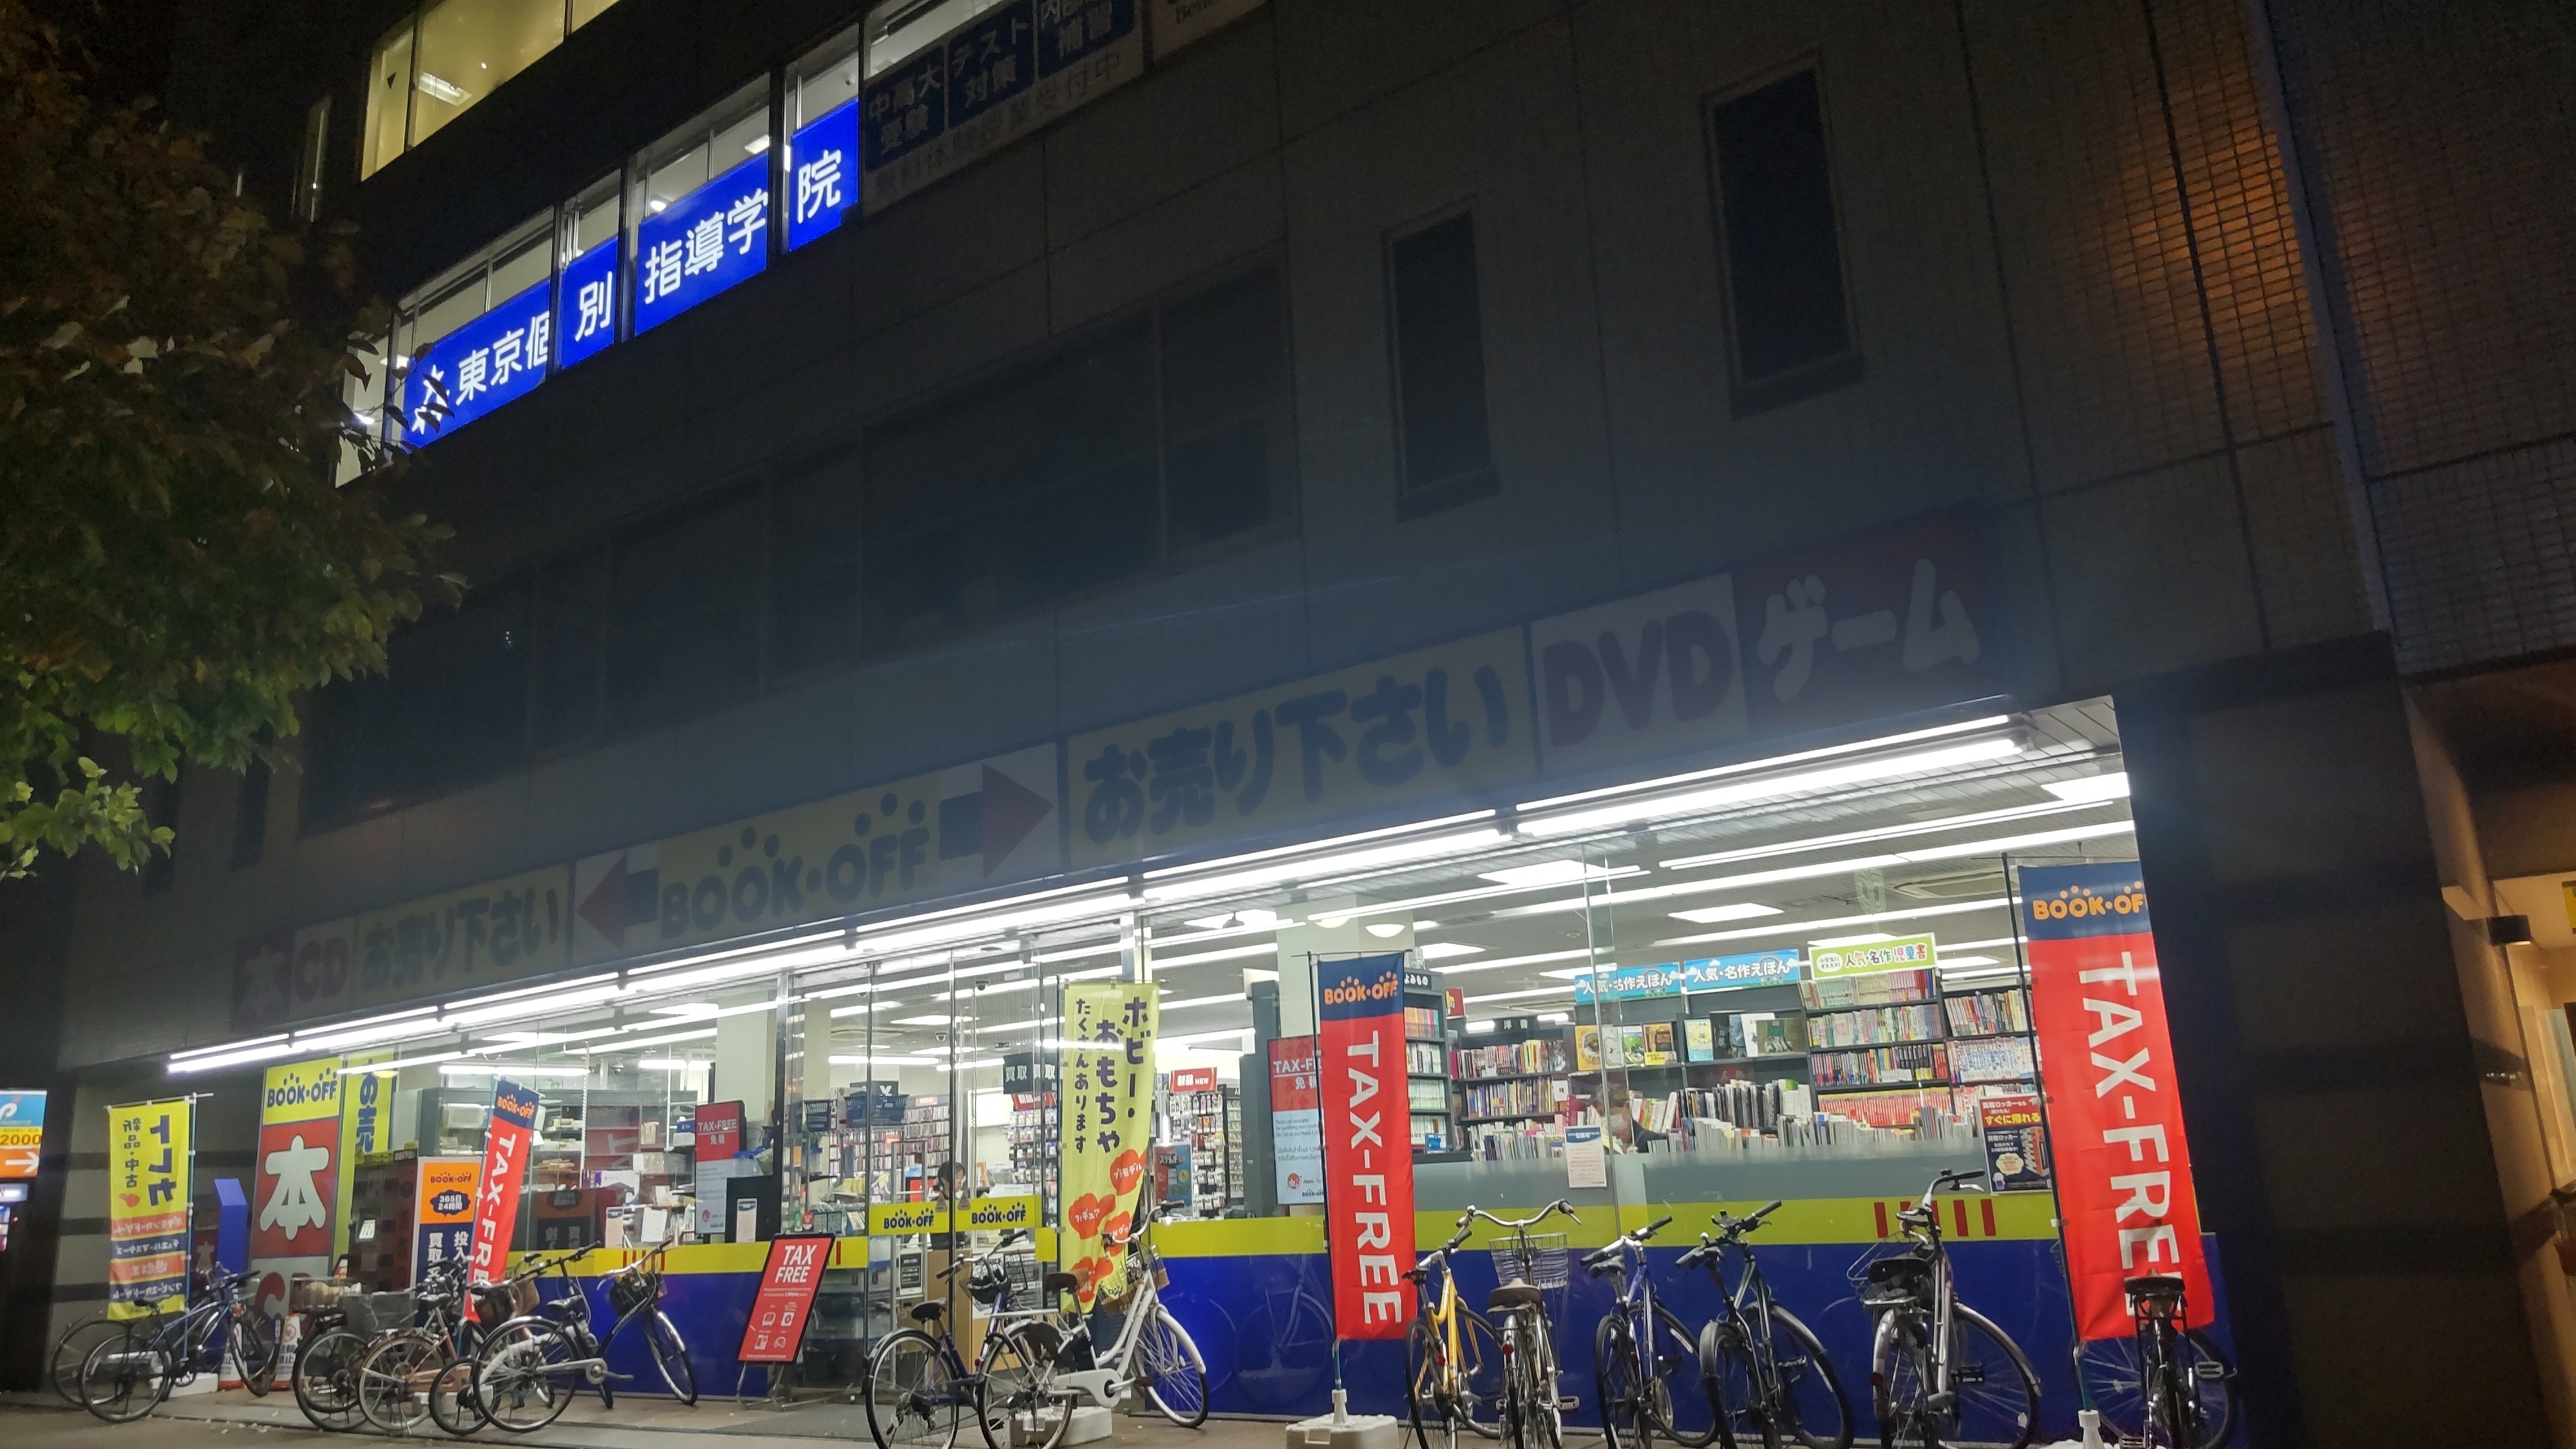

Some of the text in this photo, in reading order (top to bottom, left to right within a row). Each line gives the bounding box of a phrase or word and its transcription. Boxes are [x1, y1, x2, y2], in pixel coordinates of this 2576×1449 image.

[952, 17, 1029, 77] テスト
[1544, 608, 1739, 748] DVD
[1757, 557, 1981, 703] ゲーム
[1084, 663, 1510, 845] お売り下さい
[294, 936, 350, 1002] CD
[362, 886, 559, 992] お売り下さい
[1693, 960, 1791, 983] 人気・名作えほん
[1005, 1065, 1027, 1083] 買取
[1094, 1019, 1124, 1154] おもちゃ
[1177, 1074, 1209, 1087] 新品 NEW
[1346, 1029, 1402, 1325] TAX-FREE
[2078, 951, 2185, 1316] TAX-FRE
[260, 1135, 329, 1241] 本
[775, 1265, 811, 1284] FREE
[783, 1244, 818, 1266] TAX
